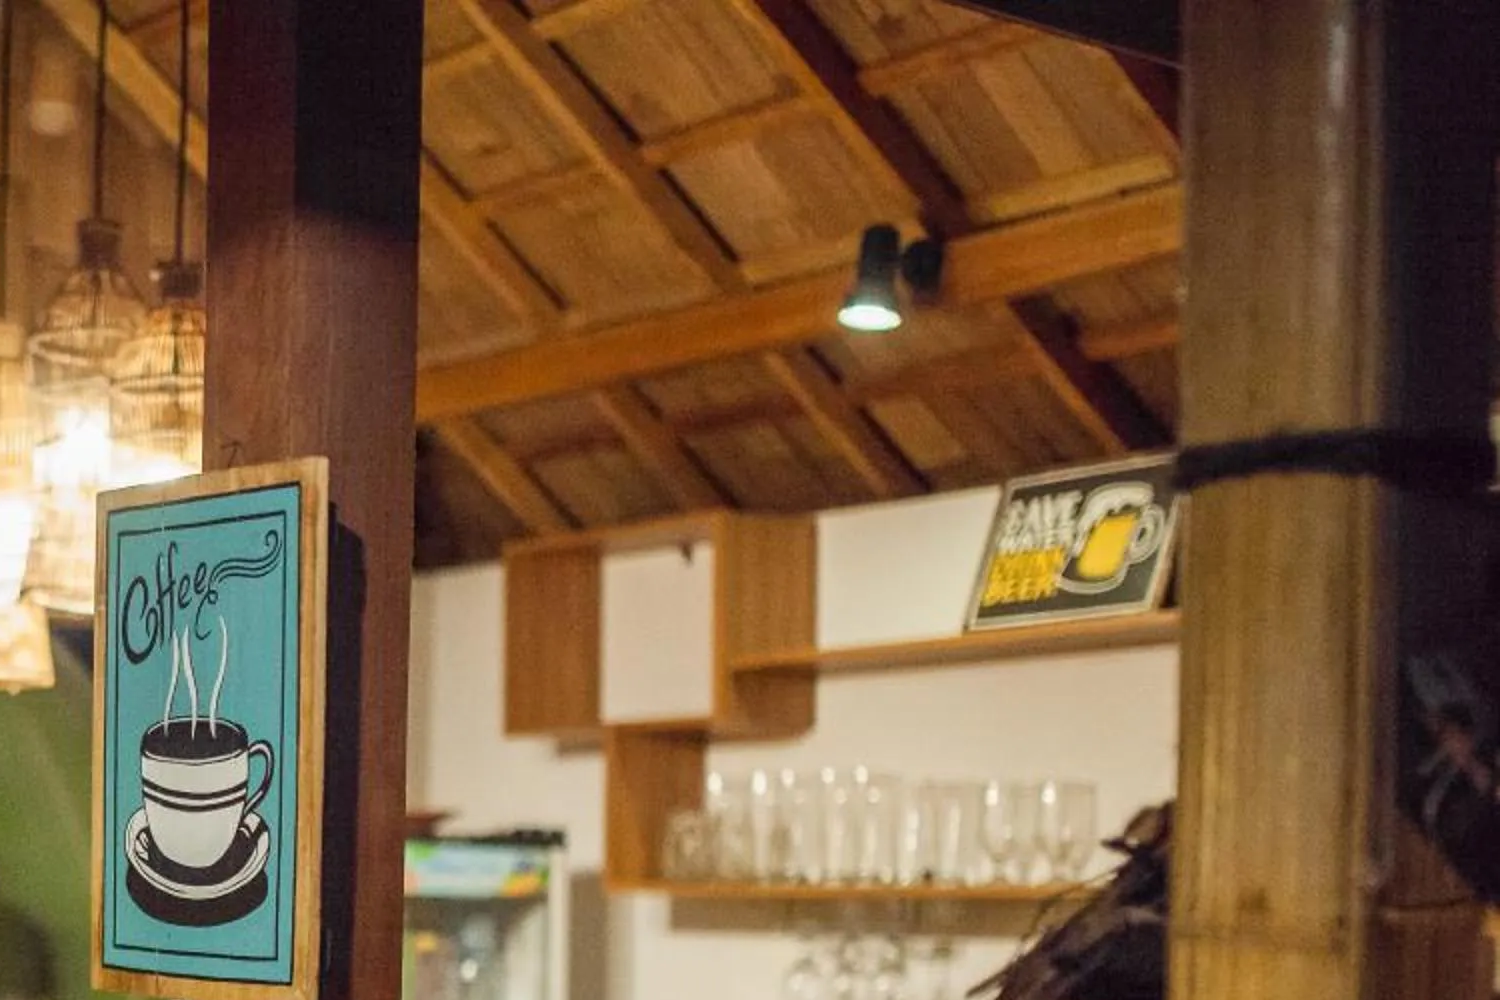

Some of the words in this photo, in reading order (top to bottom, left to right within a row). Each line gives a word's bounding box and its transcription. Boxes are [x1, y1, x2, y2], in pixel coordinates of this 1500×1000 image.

[1004, 489, 1083, 532] SAVE
[122, 529, 283, 665] Coffee
[981, 575, 1061, 607] BEER
